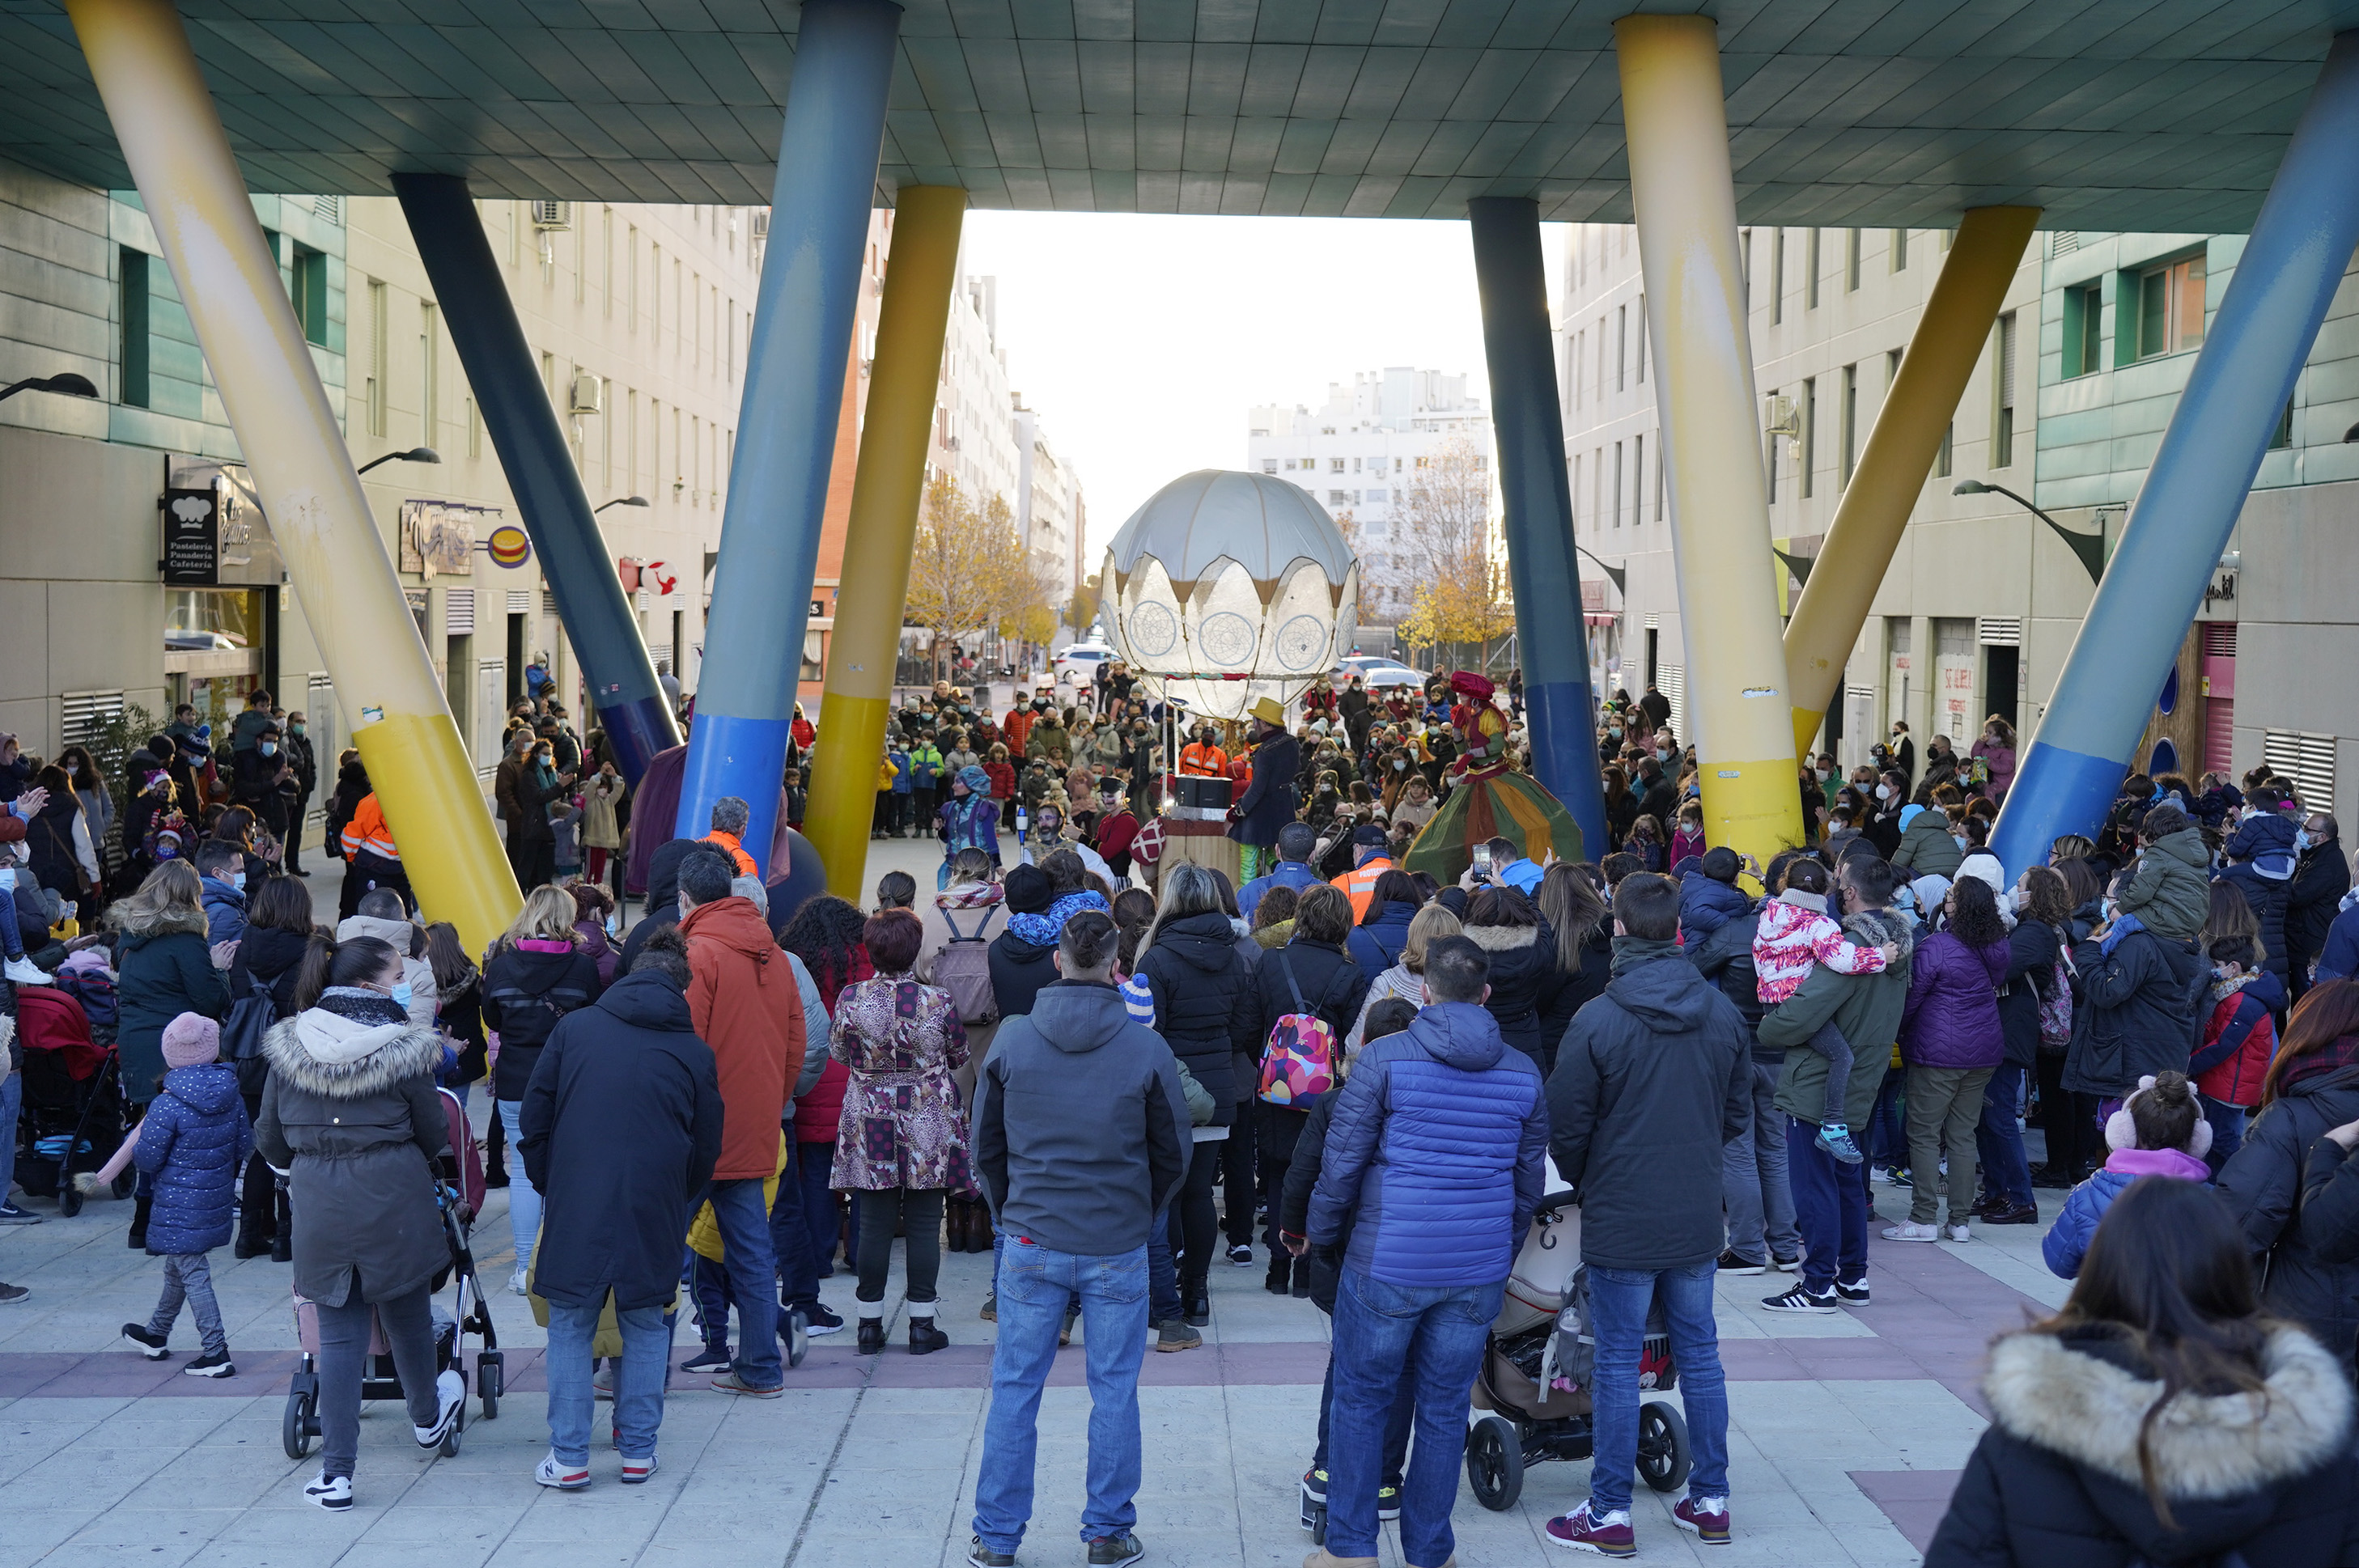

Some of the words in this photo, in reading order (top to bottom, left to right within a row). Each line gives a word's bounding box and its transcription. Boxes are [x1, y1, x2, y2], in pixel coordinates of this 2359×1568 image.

[170, 542, 213, 550] Pastelería
[170, 551, 213, 560] Panadería
[169, 560, 213, 569] Cafetería
